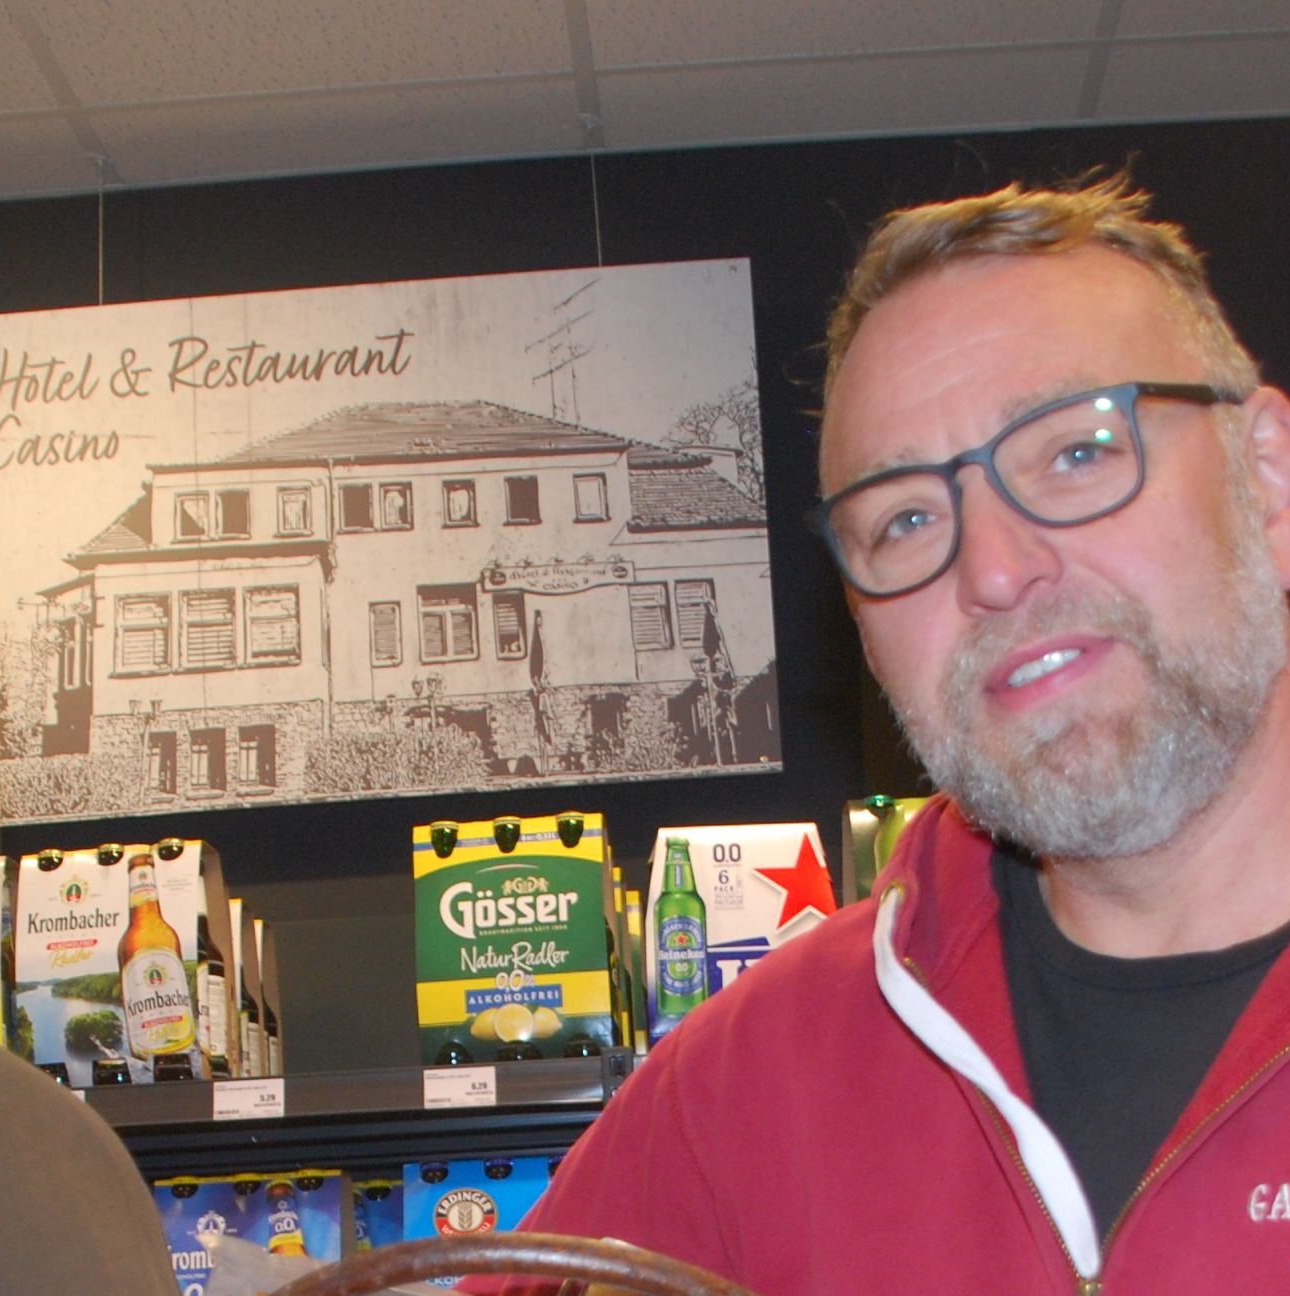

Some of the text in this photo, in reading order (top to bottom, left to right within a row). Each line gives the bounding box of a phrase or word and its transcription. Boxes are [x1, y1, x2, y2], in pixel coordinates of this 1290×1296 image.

[109, 346, 153, 398] &
[167, 328, 415, 394] Restaurant
[717, 869, 730, 885] 6
[27, 909, 121, 935] Krombacher
[439, 881, 579, 940] Gösser
[467, 989, 560, 1006] ALKOHOLFREI
[437, 1191, 493, 1215] ERDINGER
